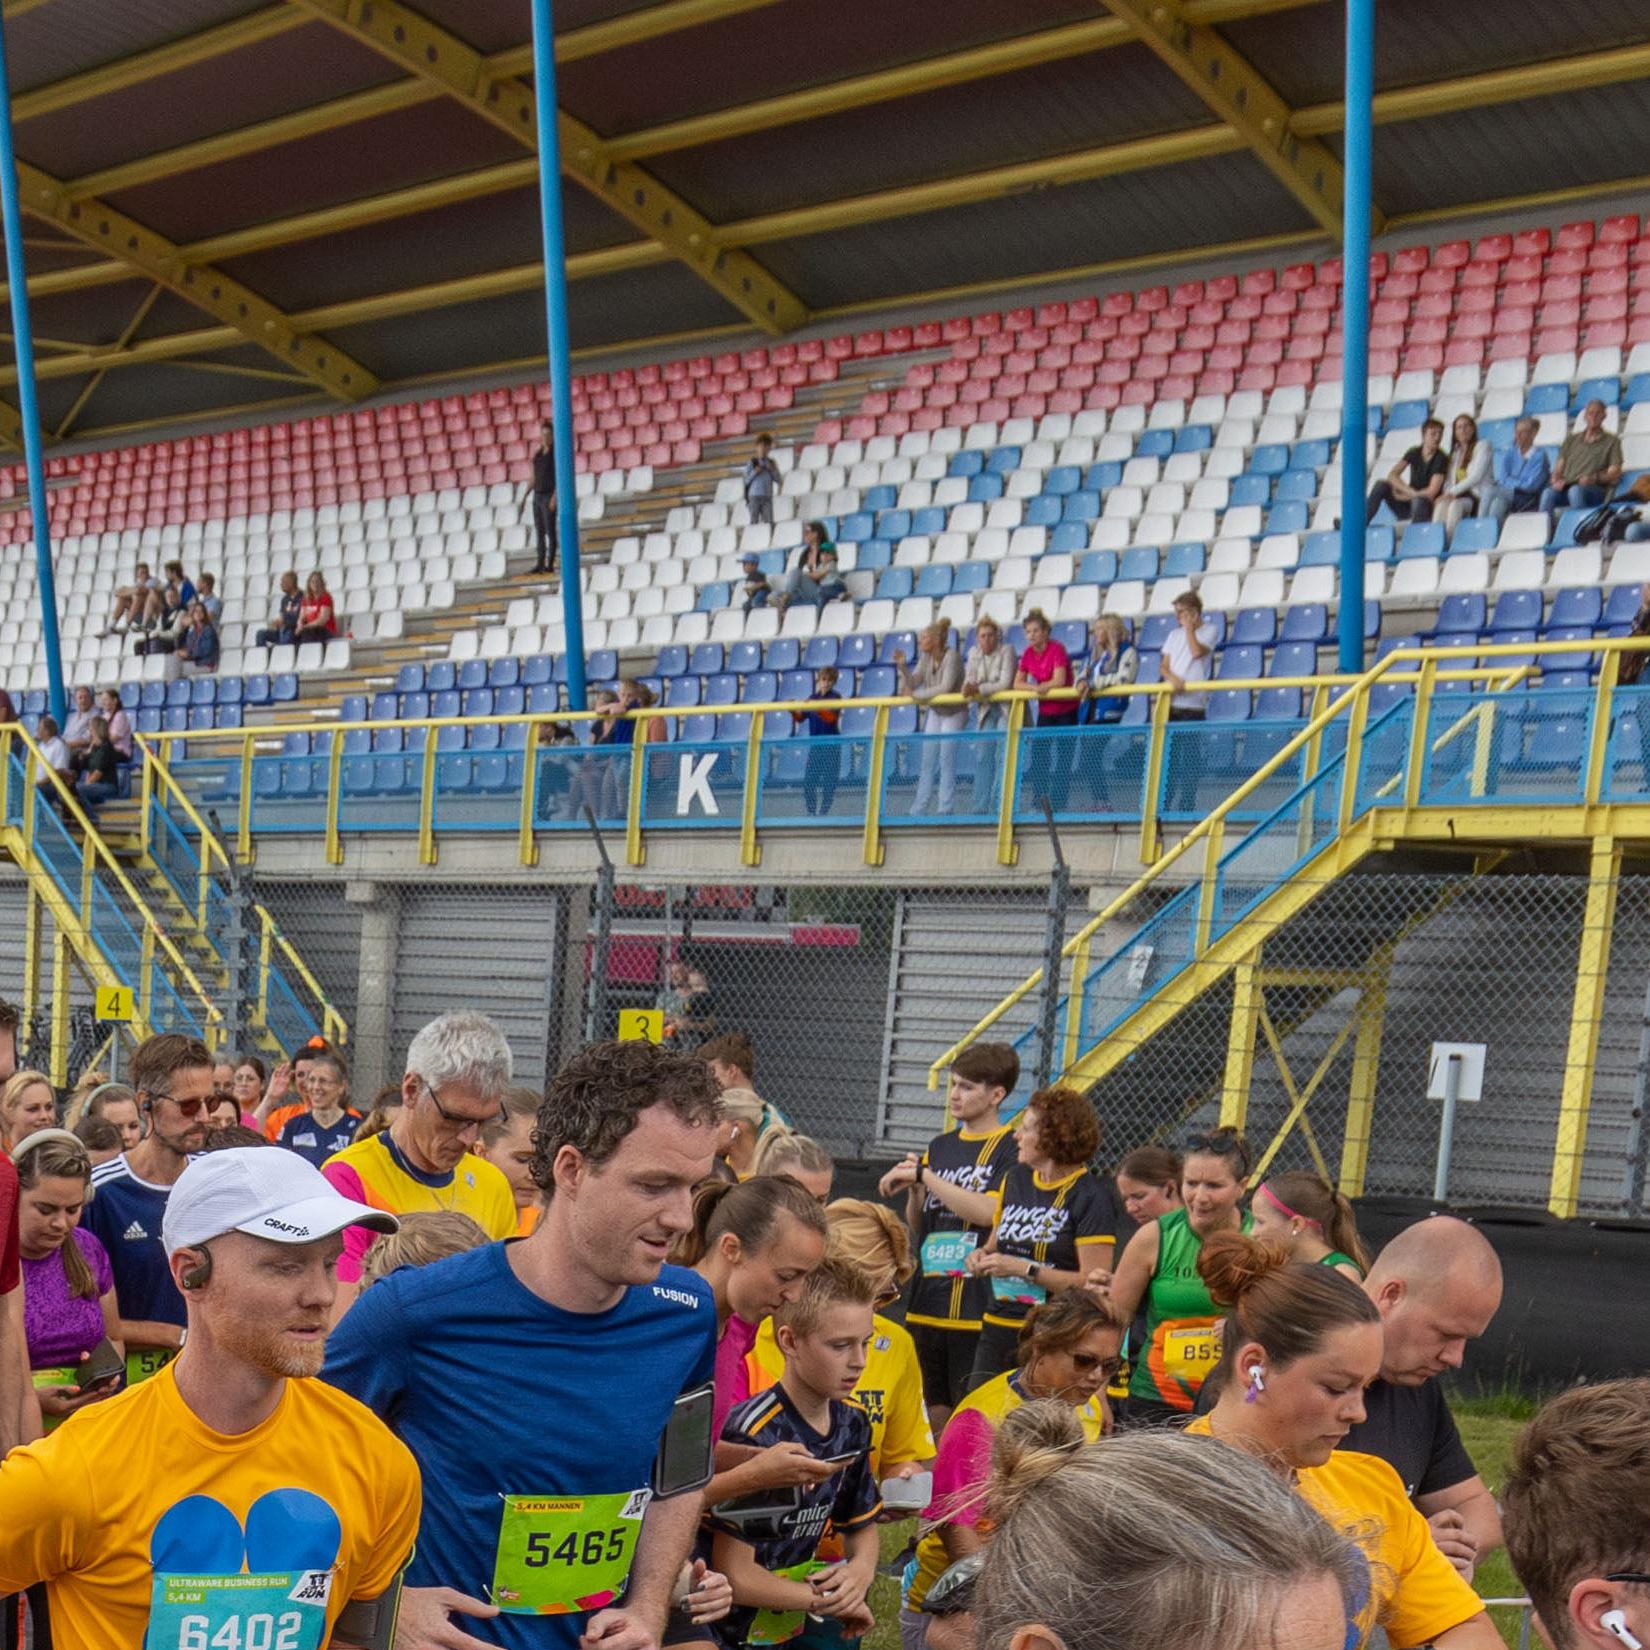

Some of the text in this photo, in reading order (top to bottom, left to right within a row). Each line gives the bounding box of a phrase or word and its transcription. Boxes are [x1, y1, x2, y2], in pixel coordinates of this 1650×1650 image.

[677, 753, 719, 816] K
[107, 991, 122, 1017] 4
[635, 1015, 651, 1041] 3
[264, 1218, 301, 1236] CRAFT
[653, 1286, 700, 1309] FUSION
[525, 1527, 627, 1568] 5465
[168, 1576, 289, 1588] ULTRAWARE BUSINESS RUN
[168, 1592, 202, 1603] 5,4 KM
